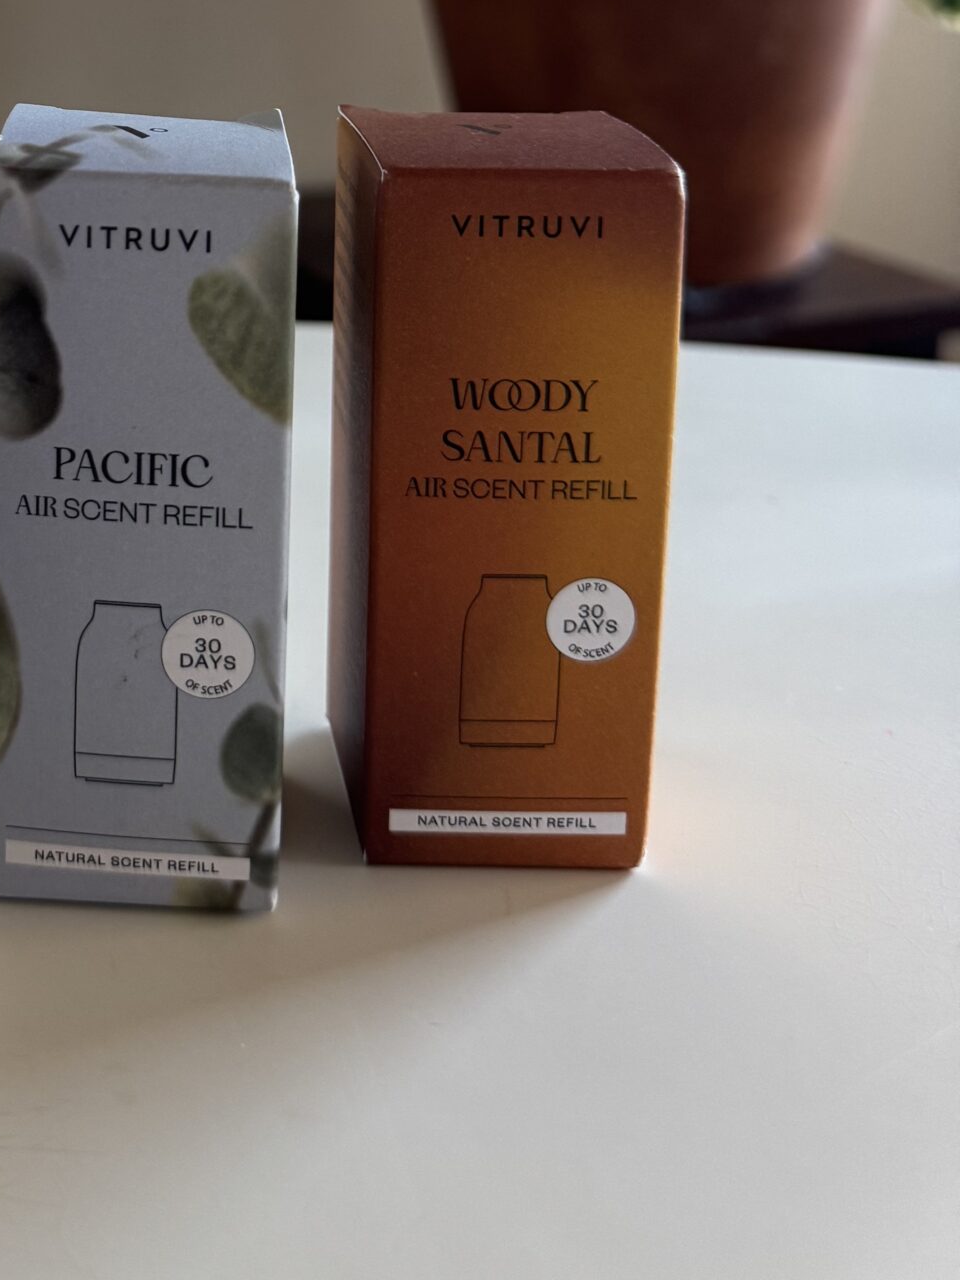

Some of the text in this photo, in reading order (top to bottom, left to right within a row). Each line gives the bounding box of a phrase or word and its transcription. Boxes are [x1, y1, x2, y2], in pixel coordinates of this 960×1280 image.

[451, 214, 603, 238] VITRUVI
[59, 224, 211, 253] VITRUVI
[449, 377, 599, 412] WOODY
[441, 429, 602, 463] SANTAL
[53, 446, 213, 488] PACIFIC
[405, 477, 637, 500] AIR SCENT REFILL
[15, 494, 253, 529] AIR SCENT REFILL
[577, 582, 607, 592] UP TO
[578, 604, 604, 619] 30
[192, 615, 224, 626] UP TO
[563, 619, 618, 634] DAYS
[195, 637, 222, 654] 30
[568, 642, 614, 658] OF SCENT
[180, 653, 236, 670] DAYS
[185, 679, 233, 695] OF SCENT
[417, 815, 596, 828] NATURAL SCENT REFILL
[34, 848, 220, 873] NATURAL SCENT REFILL
